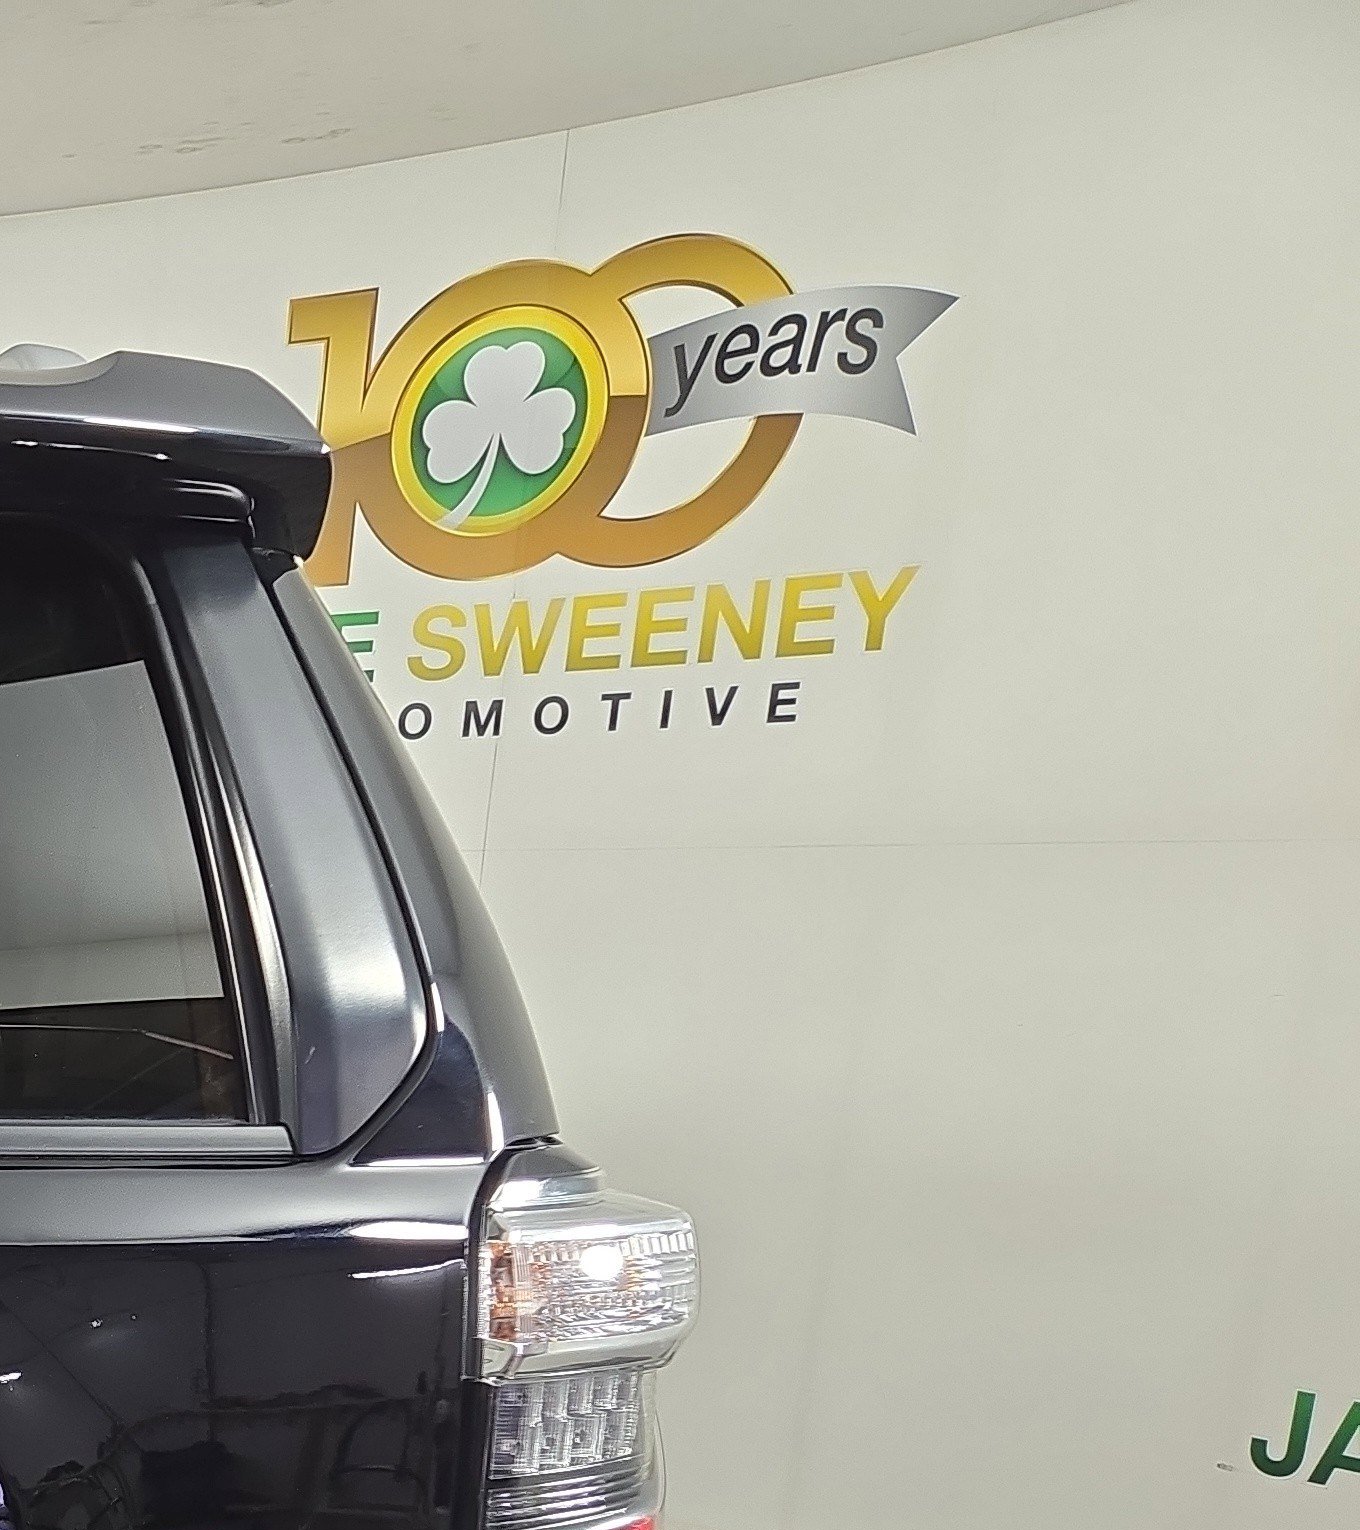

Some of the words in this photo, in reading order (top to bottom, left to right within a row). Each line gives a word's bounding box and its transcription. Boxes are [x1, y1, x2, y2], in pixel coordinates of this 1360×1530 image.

[663, 306, 884, 418] years
[406, 565, 921, 682] SWEENEY
[398, 681, 802, 741] OMOTIVE
